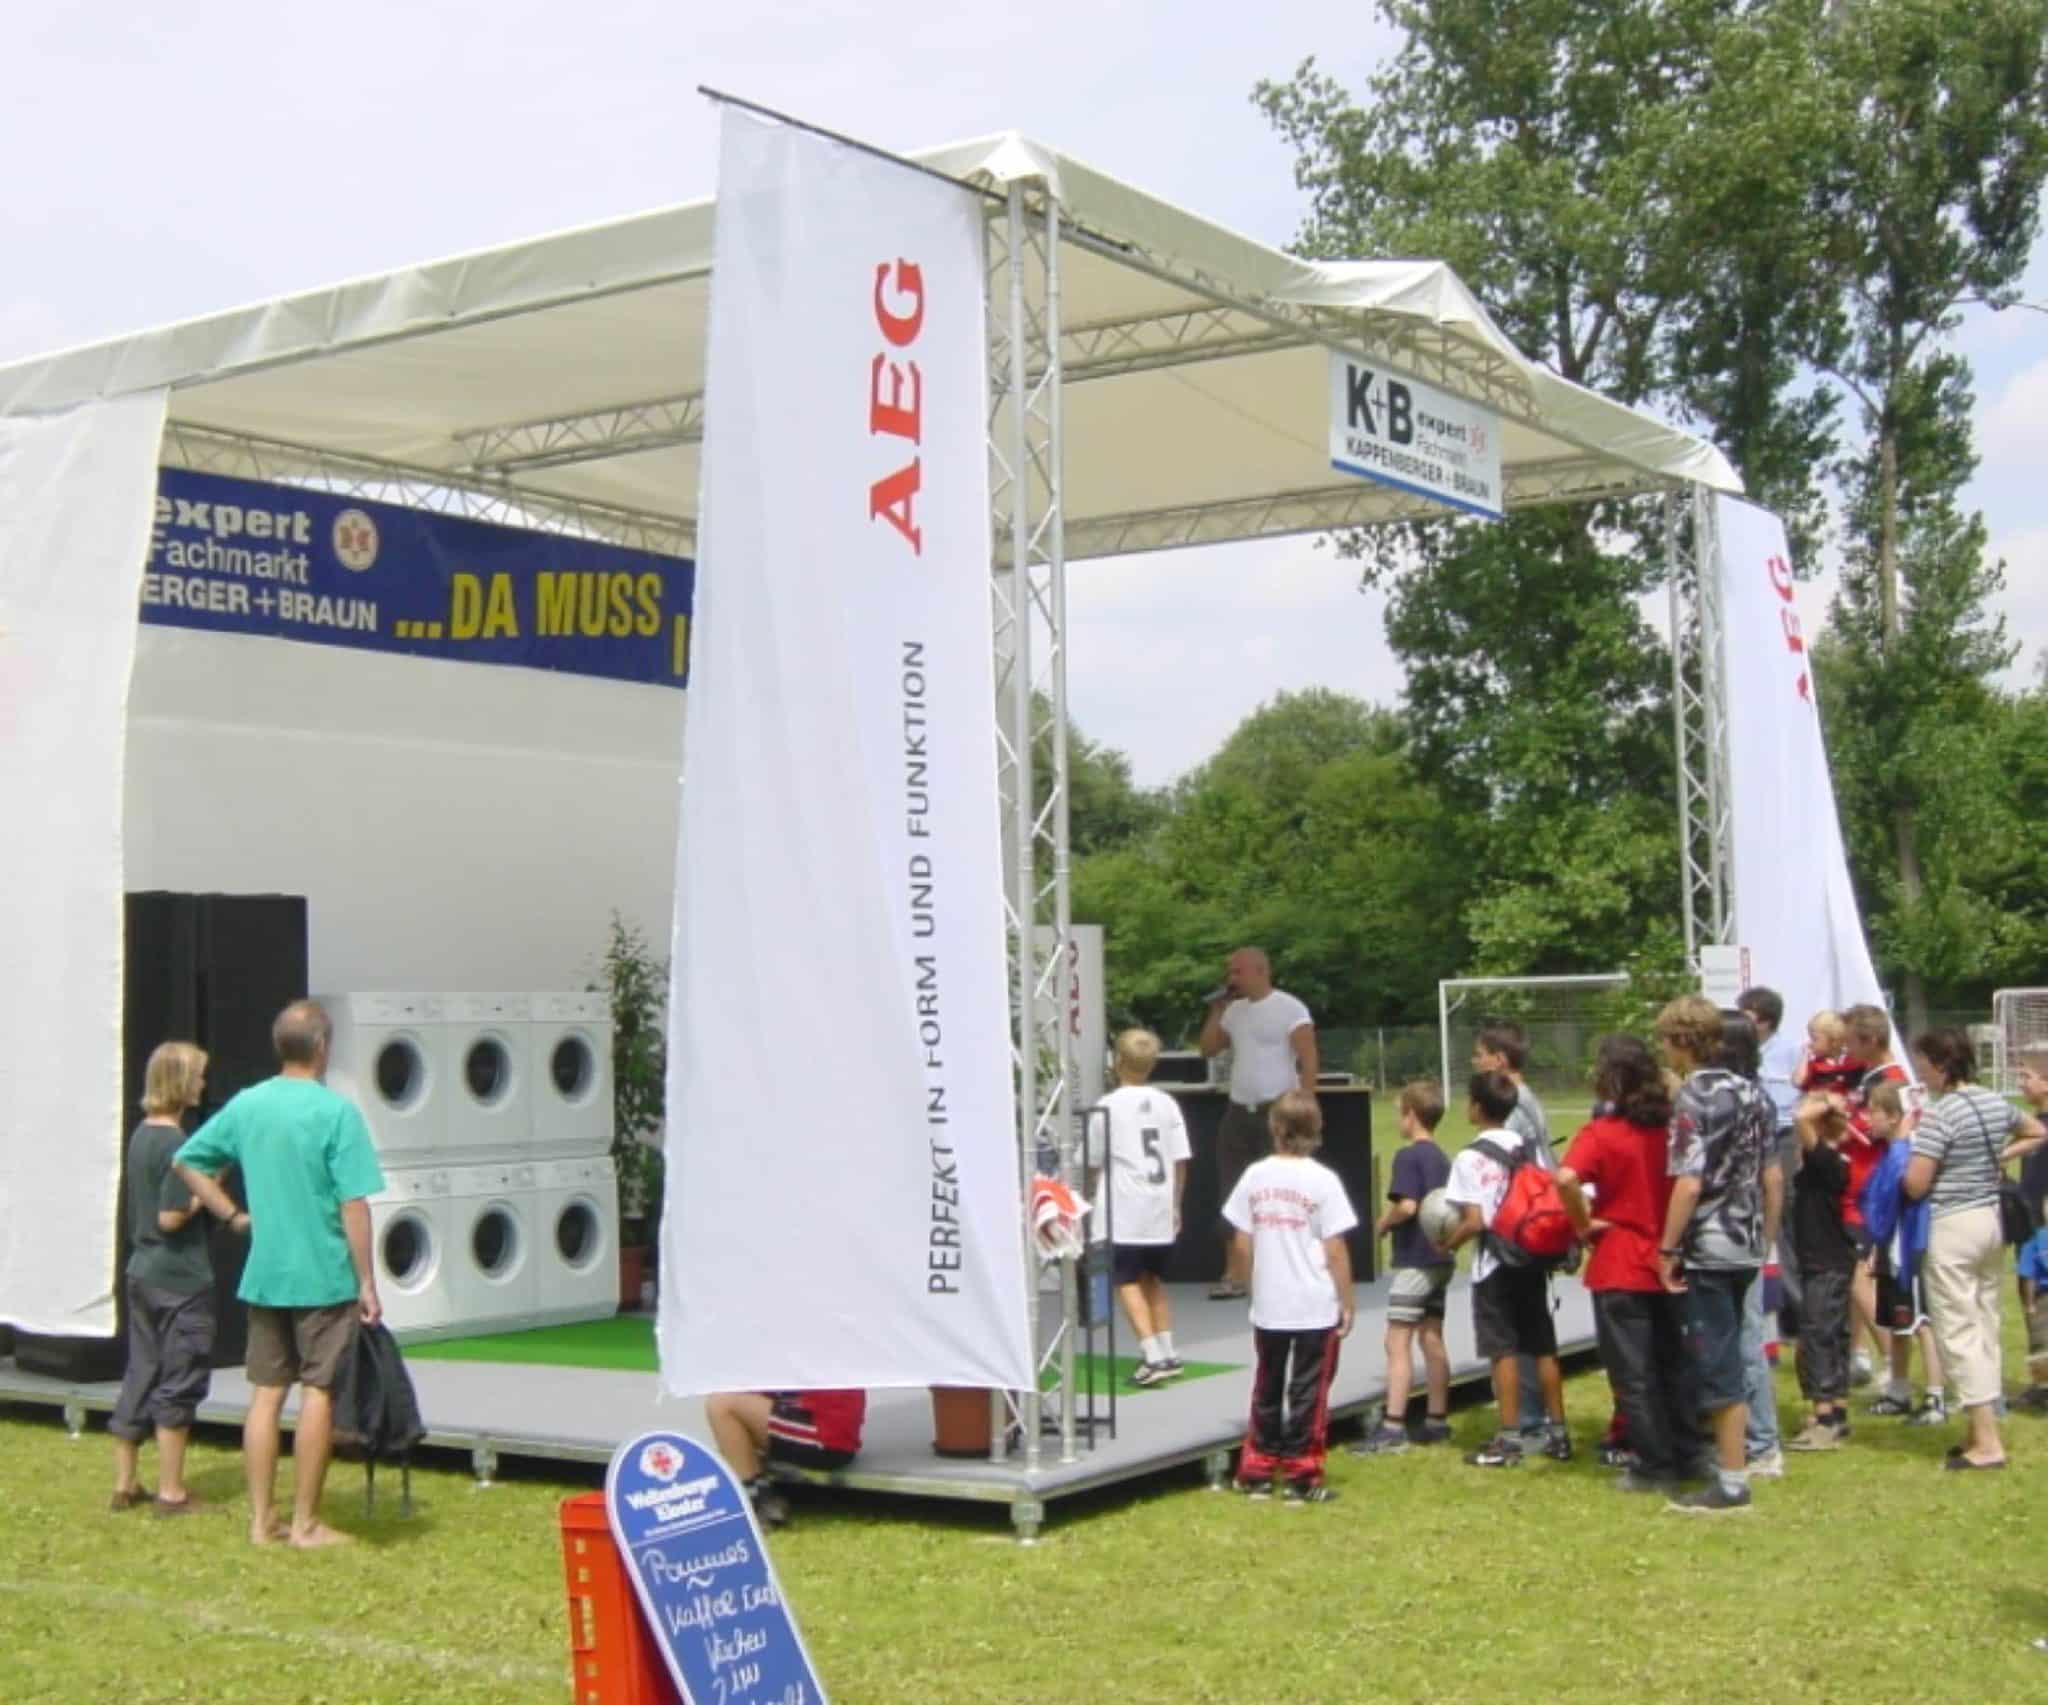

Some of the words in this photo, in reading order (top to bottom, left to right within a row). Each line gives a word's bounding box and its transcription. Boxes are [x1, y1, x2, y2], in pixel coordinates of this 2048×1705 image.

[871, 257, 925, 557] AEG
[149, 529, 310, 584] Fachmarkt
[156, 496, 312, 544] expert
[536, 571, 663, 638] MUSS
[902, 640, 931, 838] FUNKTION
[909, 854, 937, 939] UND
[915, 954, 944, 1068] FORM
[928, 1087, 949, 1124] IN
[1141, 1127, 1166, 1184] 5
[928, 1138, 962, 1295] PERFEKT
